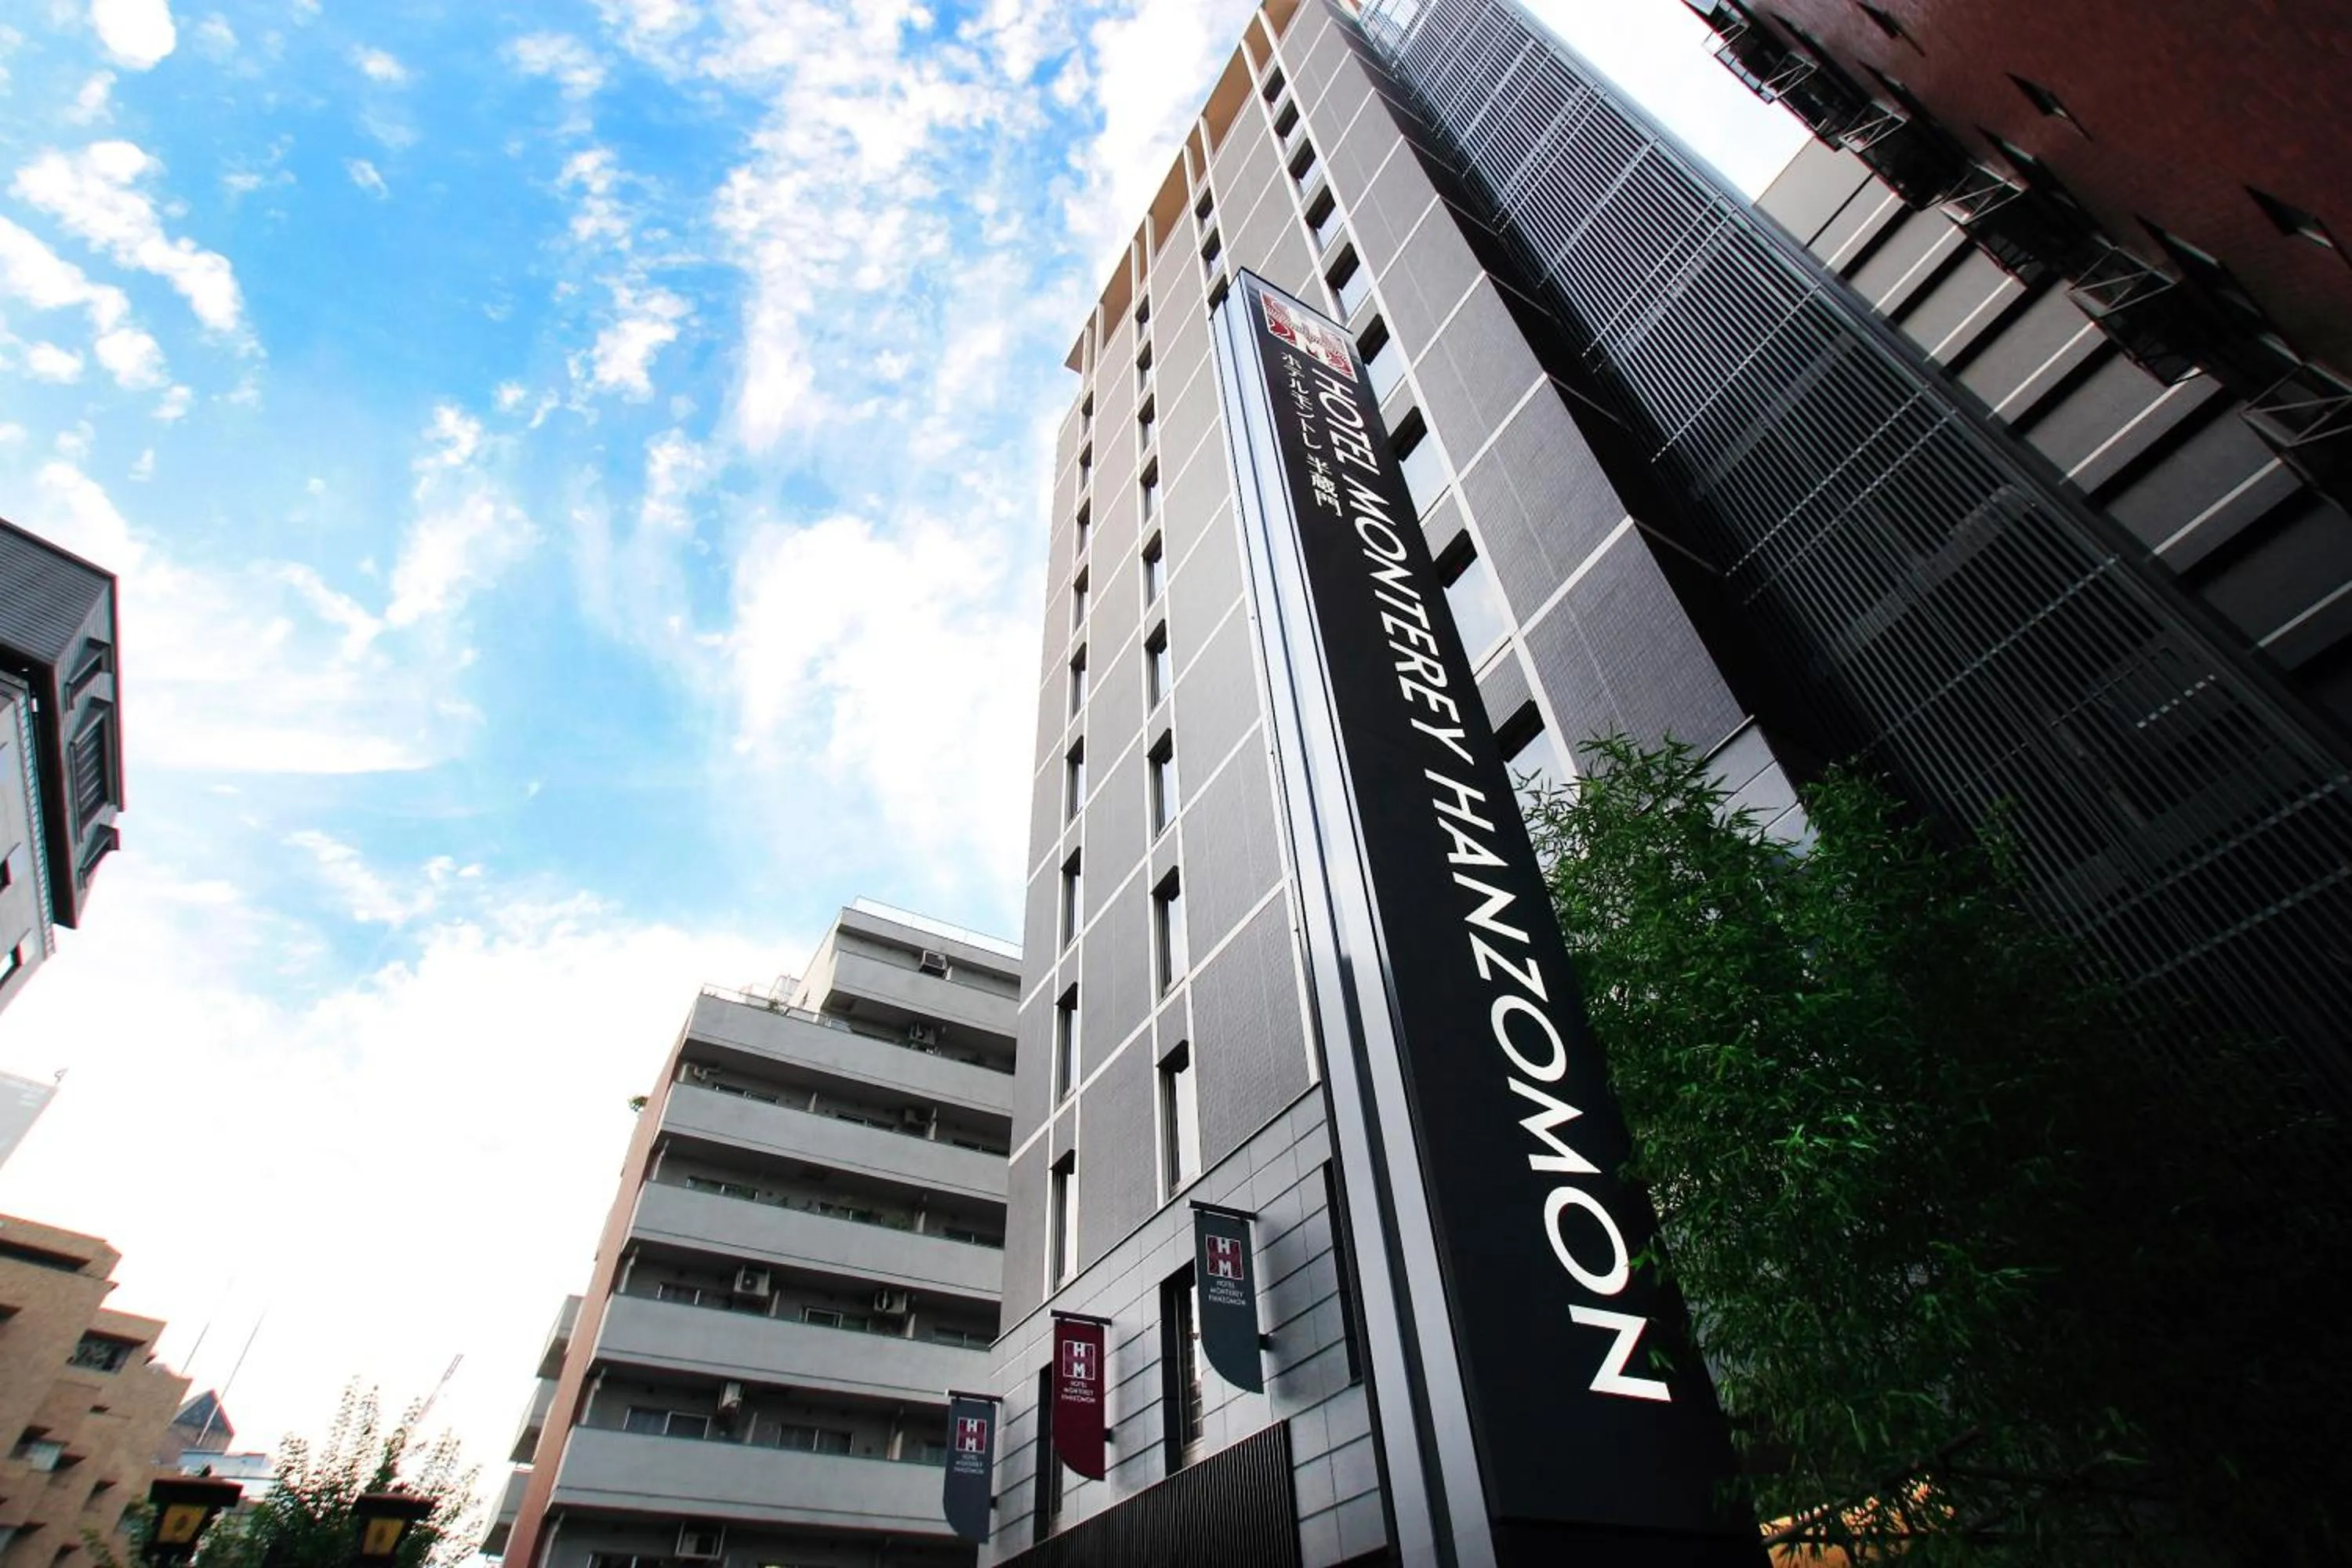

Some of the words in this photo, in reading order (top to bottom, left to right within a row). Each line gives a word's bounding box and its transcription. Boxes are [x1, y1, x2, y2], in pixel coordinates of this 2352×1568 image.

[1282, 352, 1322, 449] ホテルモントレ
[1307, 453, 1343, 517] 半蔵門
[1312, 368, 1381, 476] HOTEL
[1341, 473, 1474, 766] MONTEREY
[1425, 769, 1671, 1403] HANZOMON
